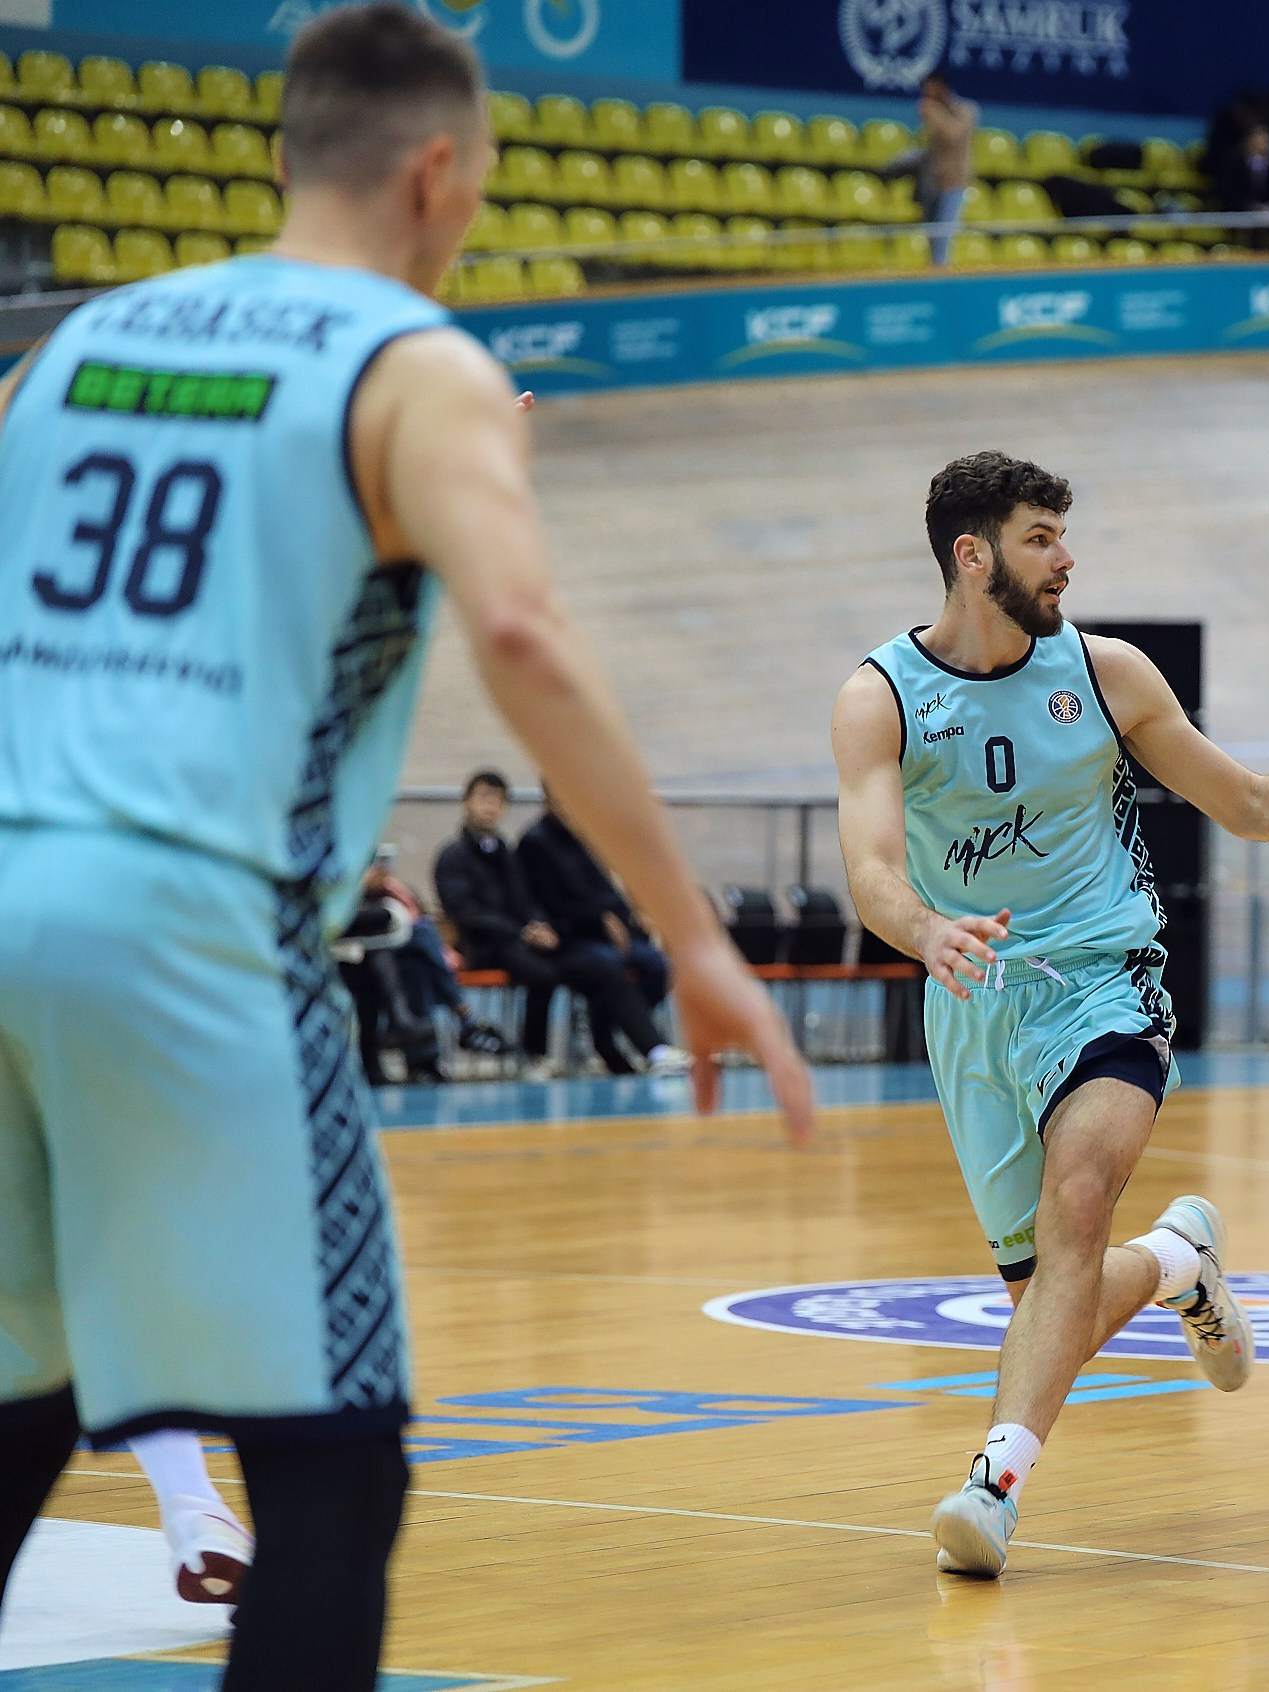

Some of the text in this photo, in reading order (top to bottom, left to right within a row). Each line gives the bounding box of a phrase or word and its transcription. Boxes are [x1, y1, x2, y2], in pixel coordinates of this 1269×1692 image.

[31, 452, 223, 619] 38
[923, 726, 965, 744] Kempa
[984, 735, 1017, 794] 0
